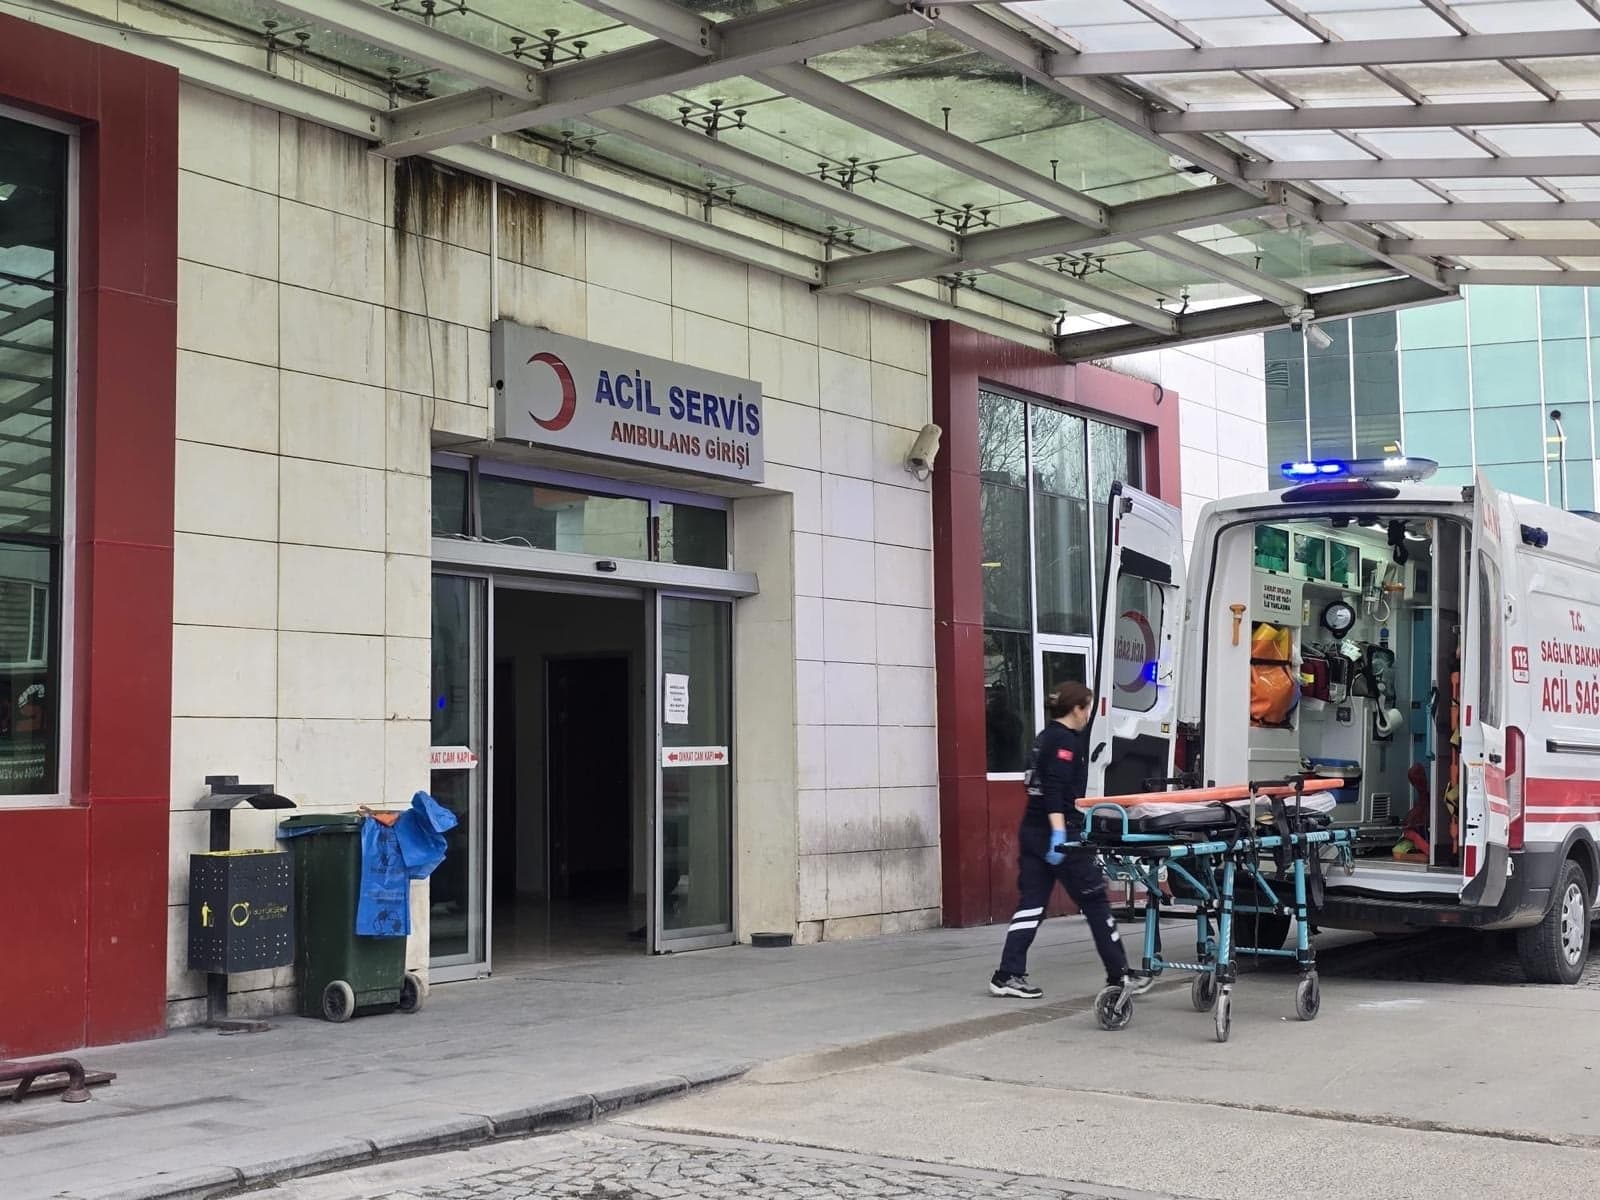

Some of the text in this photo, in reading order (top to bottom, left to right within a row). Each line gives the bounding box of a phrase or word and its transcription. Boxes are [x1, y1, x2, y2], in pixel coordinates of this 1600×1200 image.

[595, 369, 760, 436] ACİL SERVİS
[611, 421, 750, 470] AMBULANS GİRİŞİ
[1569, 609, 1585, 632] T.C.
[1514, 650, 1528, 668] 112
[1541, 637, 1573, 664] SAĞLIK
[1542, 669, 1599, 715] ACİL SAĞ
